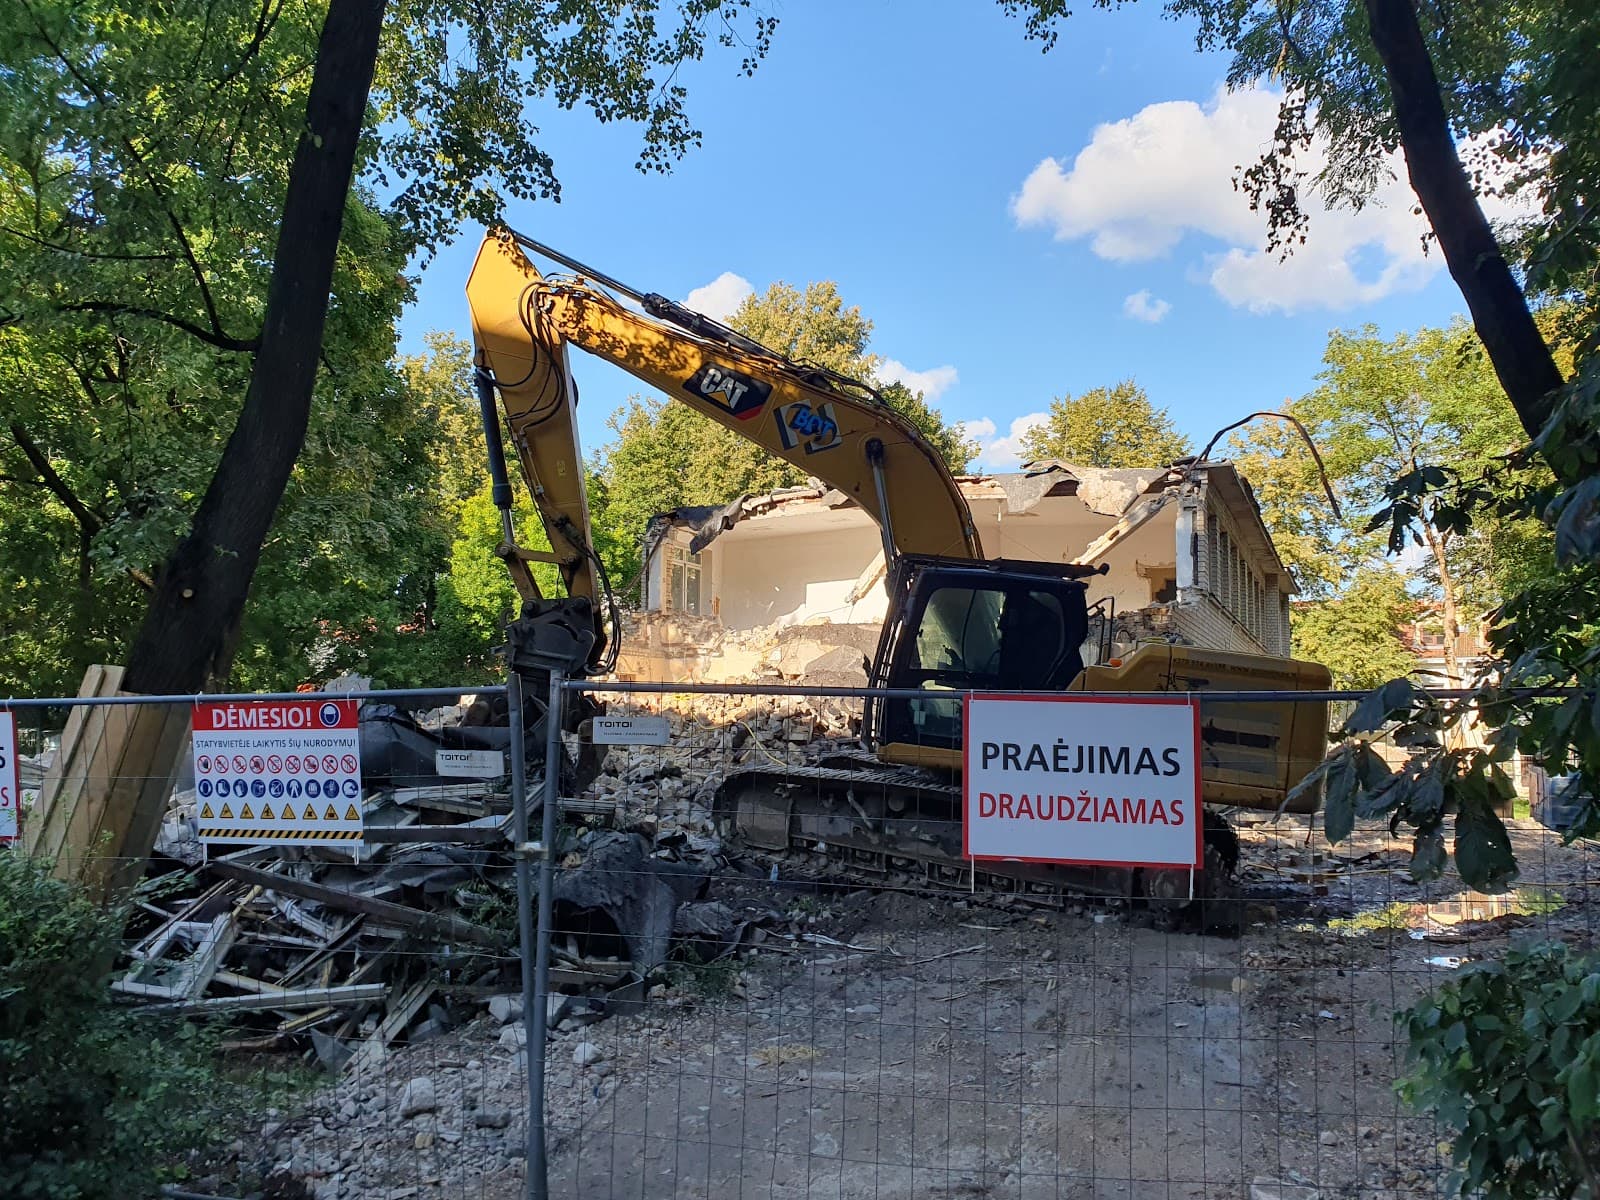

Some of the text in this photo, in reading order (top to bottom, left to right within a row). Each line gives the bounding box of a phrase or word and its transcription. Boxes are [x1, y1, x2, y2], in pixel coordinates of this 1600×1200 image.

[700, 368, 748, 409] CAT
[212, 704, 312, 728] DĖMESIO!
[195, 739, 250, 748] STATYBVIETĖJE
[252, 738, 287, 748] LAIKYTIS
[981, 738, 1181, 776] PRAĖJIMAS
[978, 790, 1185, 826] DRAUDŽIAMAS
